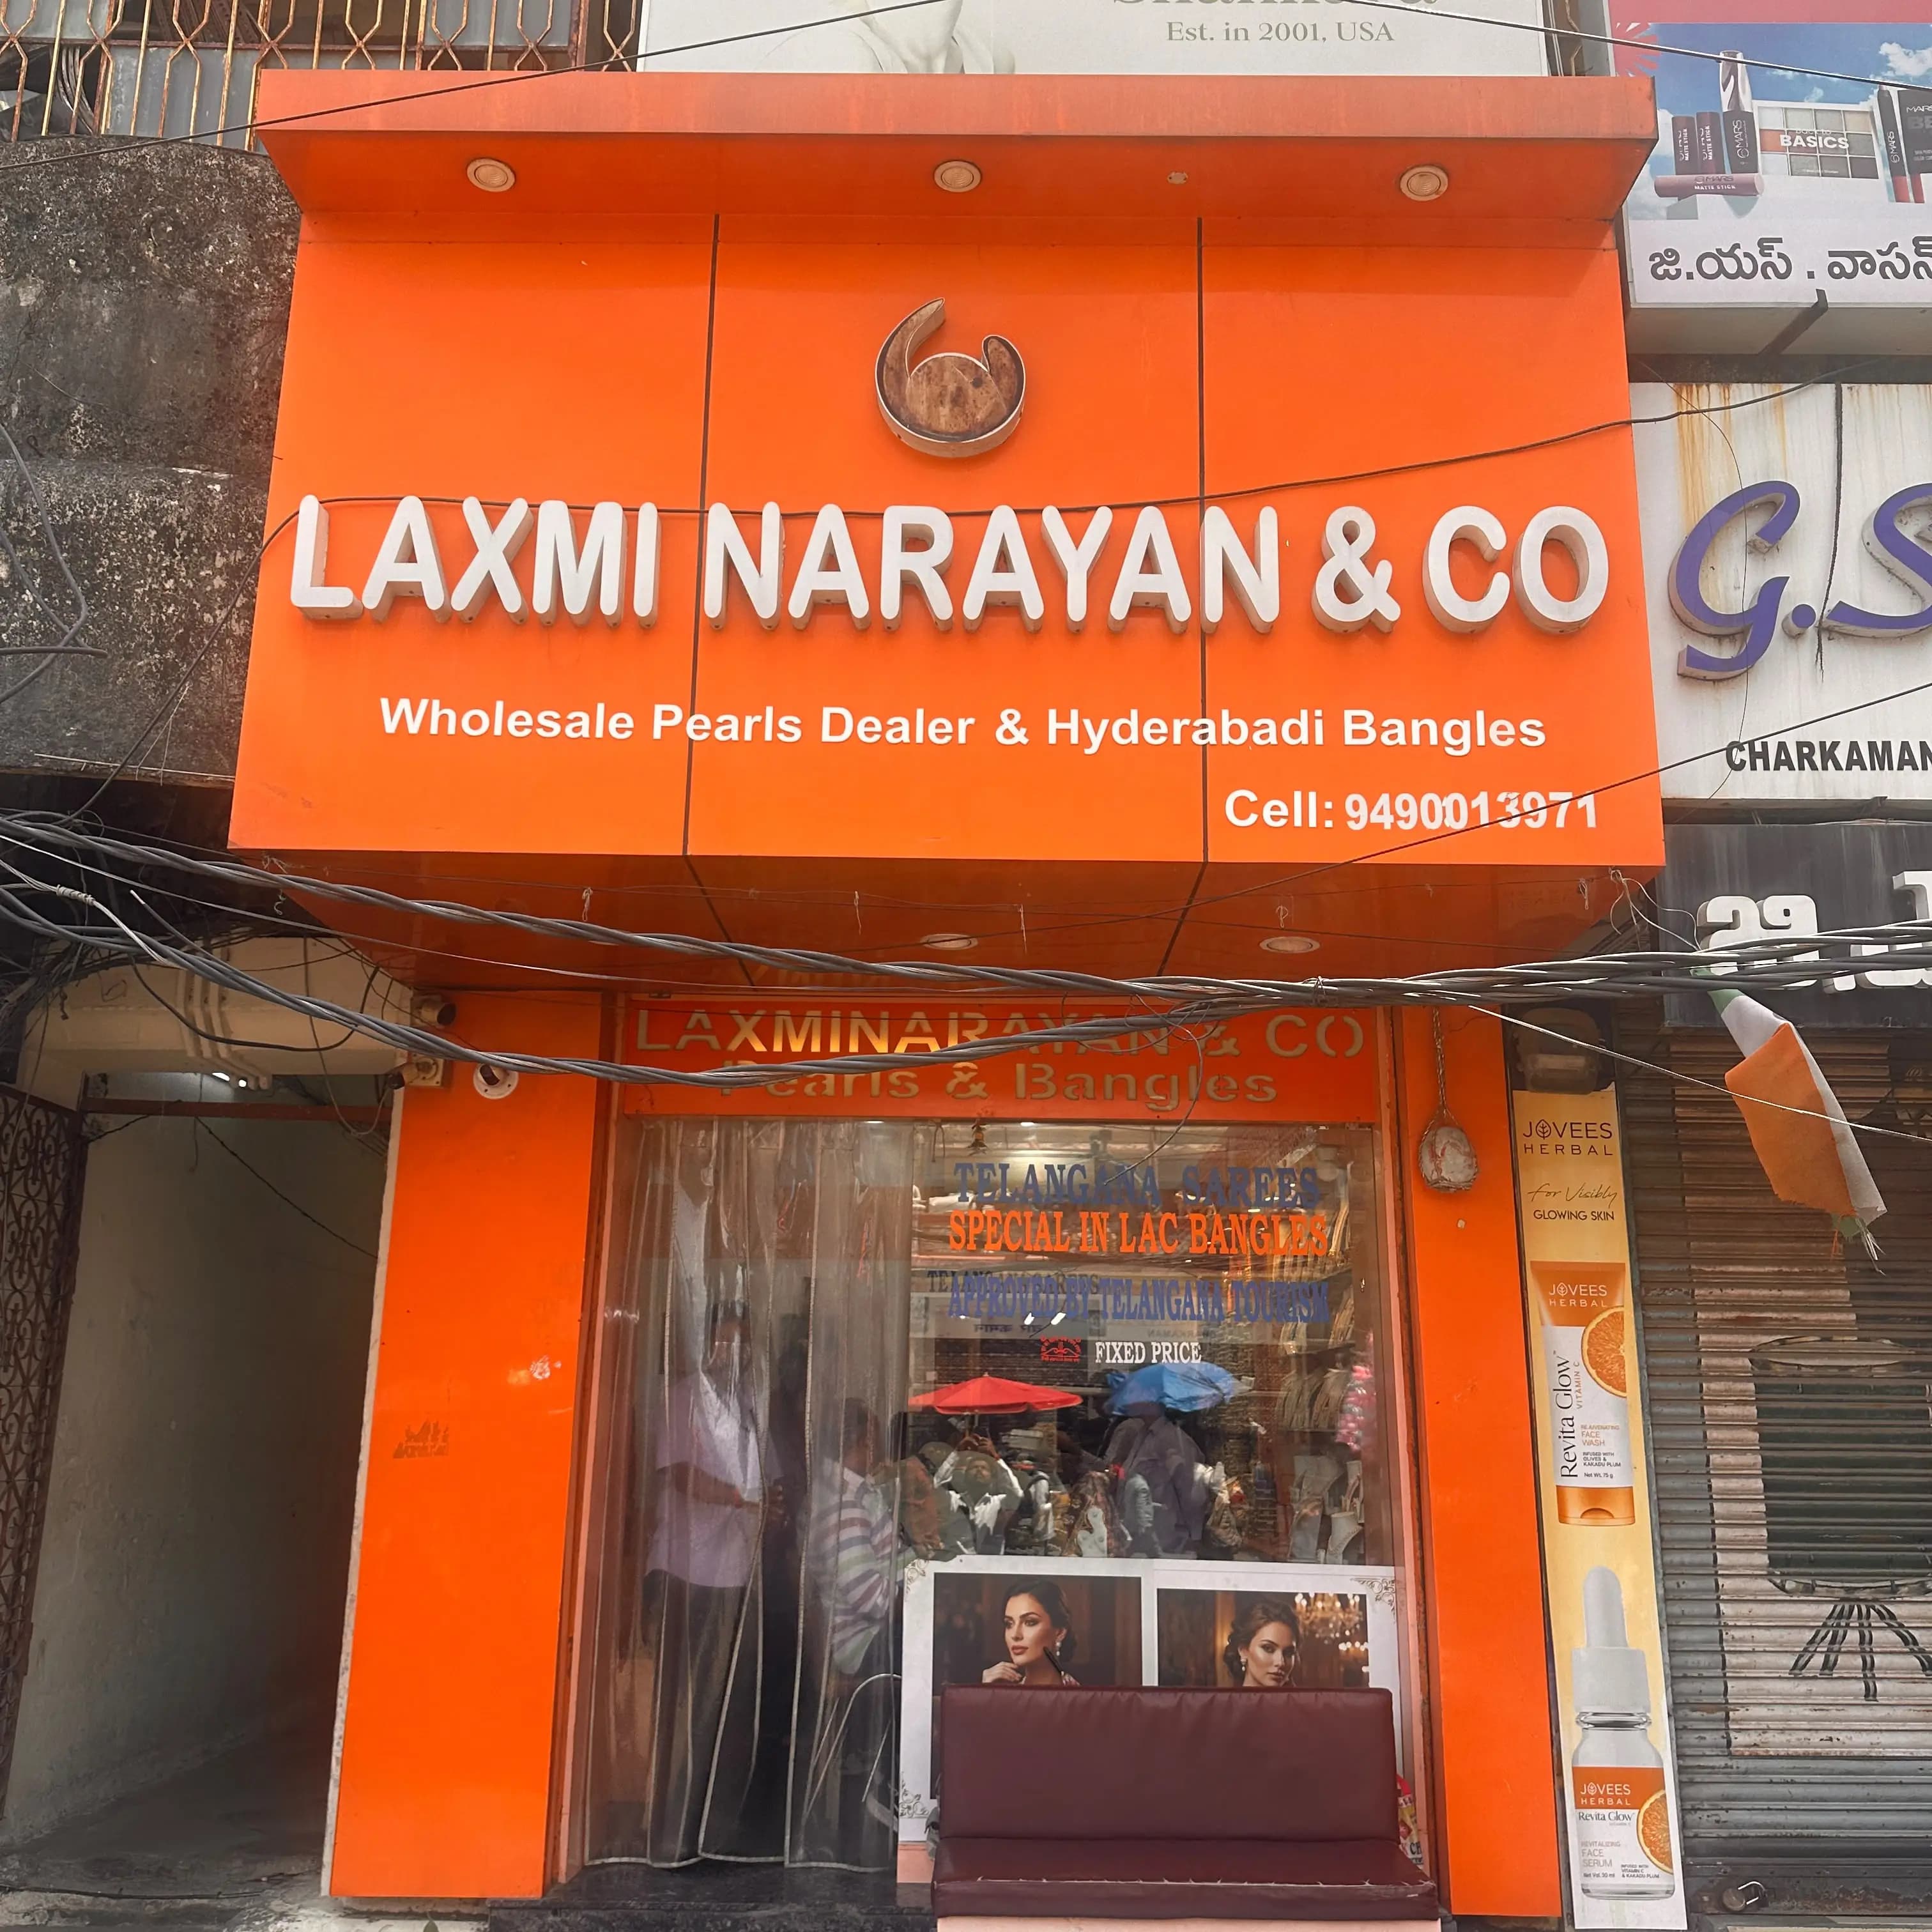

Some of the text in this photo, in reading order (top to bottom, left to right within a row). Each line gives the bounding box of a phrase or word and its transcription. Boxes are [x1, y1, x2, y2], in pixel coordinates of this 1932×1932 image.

[1167, 22, 1395, 43] Est. in 2001, USA
[1733, 119, 1744, 148] MARS
[1780, 134, 1850, 149] BASICS
[291, 494, 1609, 631] LAXMI NARAYAN & CO
[381, 698, 1545, 756] Wholesale Pearls Dealer & Hyderabadi Bangles
[1225, 789, 1597, 830] Cell: 9490013971
[1266, 1015, 1364, 1058] CO
[945, 1062, 989, 1100] &
[1015, 1062, 1278, 1112] Bangles
[1523, 1119, 1613, 1140] JOVEES
[1524, 1143, 1613, 1156] HERBAL
[954, 1163, 1321, 1209] TELANGANA SAREES
[1565, 1182, 1618, 1209] Visibly
[1533, 1209, 1614, 1221] GLOWING SKIN
[949, 1209, 1328, 1256] SPECIAL IN LAC BANGLES
[947, 1275, 1059, 1319] APPROVED
[1065, 1276, 1093, 1319] BY
[1099, 1278, 1223, 1321] TELANGANA
[1230, 1279, 1330, 1323] TOURISM
[1549, 1282, 1607, 1298] JOVEES
[1549, 1298, 1608, 1308] HERBAL
[1096, 1342, 1146, 1364] FIXED
[1151, 1342, 1202, 1364] PRICE
[1574, 1371, 1583, 1409] VITAMIN
[1558, 1416, 1578, 1477] Revita
[1580, 1782, 1631, 1796] JOVEES
[1581, 1797, 1631, 1805] HERBAL
[1579, 1811, 1606, 1821] Revita
[1581, 1848, 1605, 1857] FACE
[1583, 1859, 1613, 1867] SERUM
